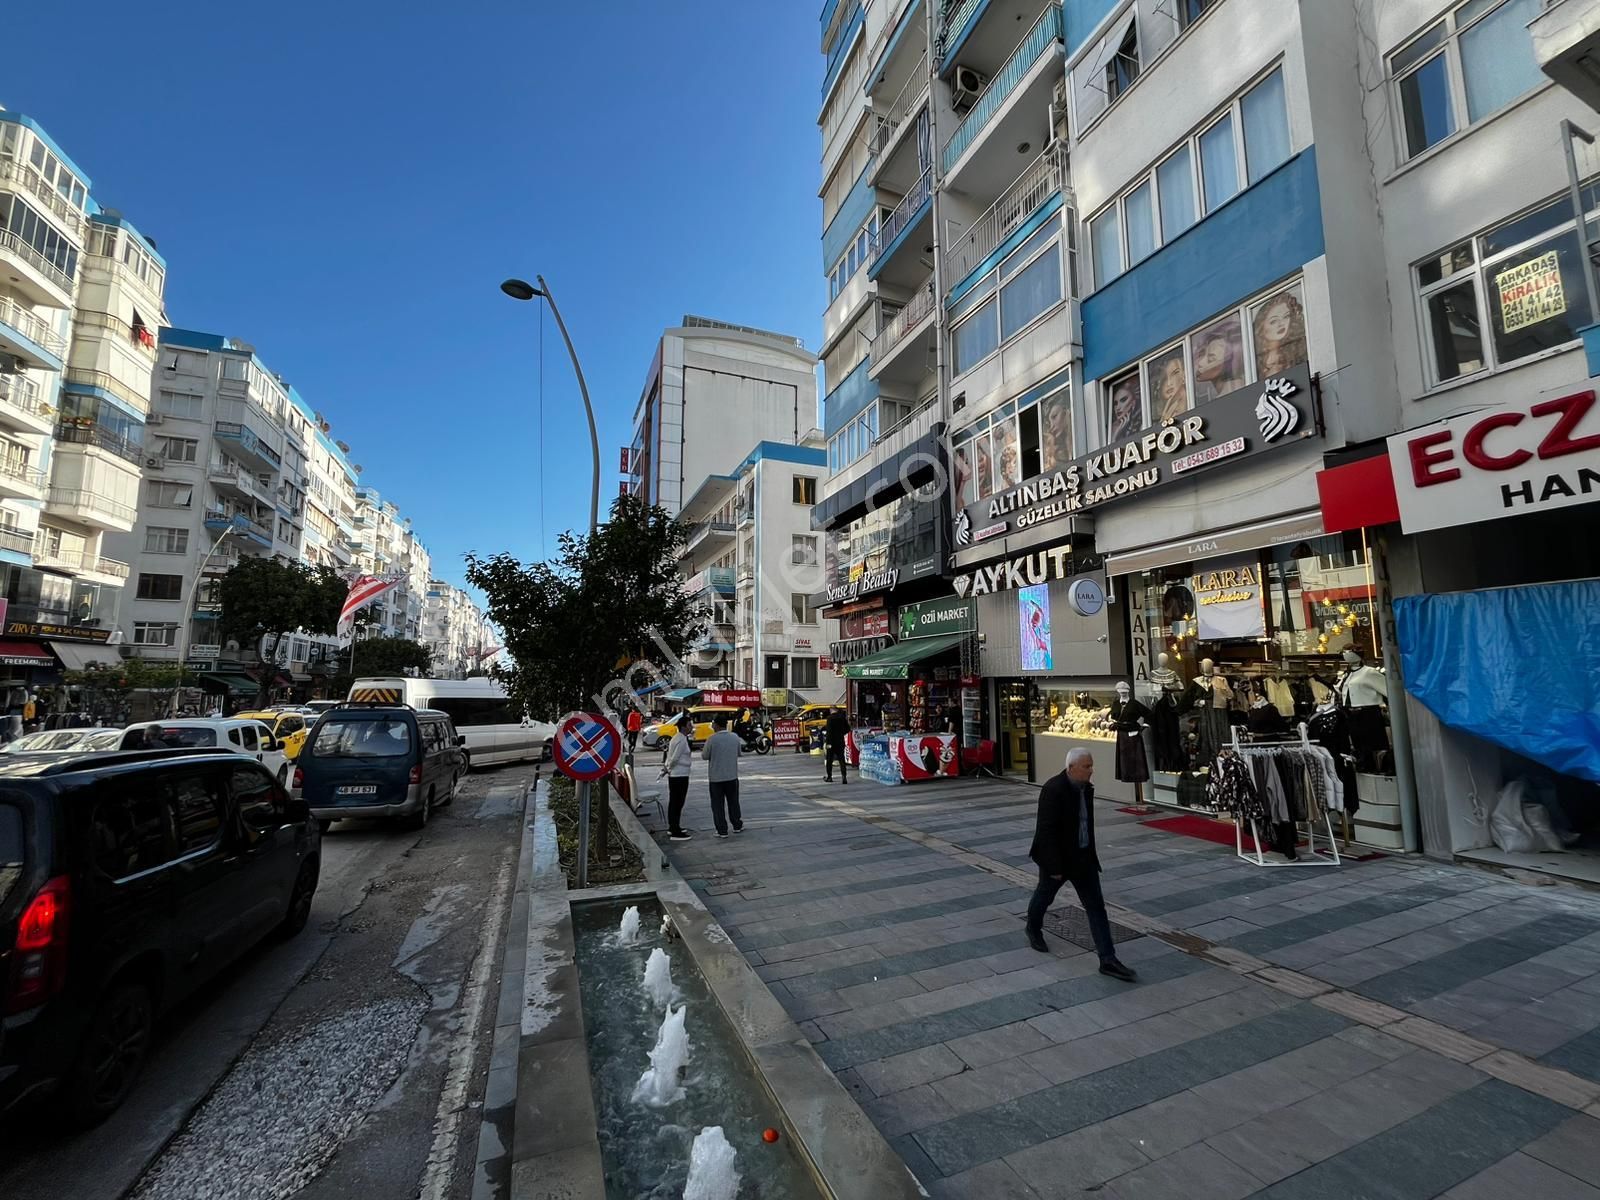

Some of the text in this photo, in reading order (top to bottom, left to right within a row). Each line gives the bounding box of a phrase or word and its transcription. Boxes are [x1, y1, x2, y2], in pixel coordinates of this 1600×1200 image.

[1504, 284, 1561, 316] 241 41 42
[1232, 439, 1243, 451] 32
[988, 415, 1206, 519] ALTINBAŞ KUAFÖR
[1016, 466, 1158, 528] GÜZELLİK SALONU
[1188, 540, 1218, 554] LARA
[826, 583, 848, 601] Sense
[849, 577, 862, 600] of
[863, 567, 898, 592] Beauty
[971, 545, 1072, 597] AYKUT
[1194, 566, 1256, 593] LARA
[937, 606, 969, 622] MARKET
[1131, 591, 1149, 681] LARA
